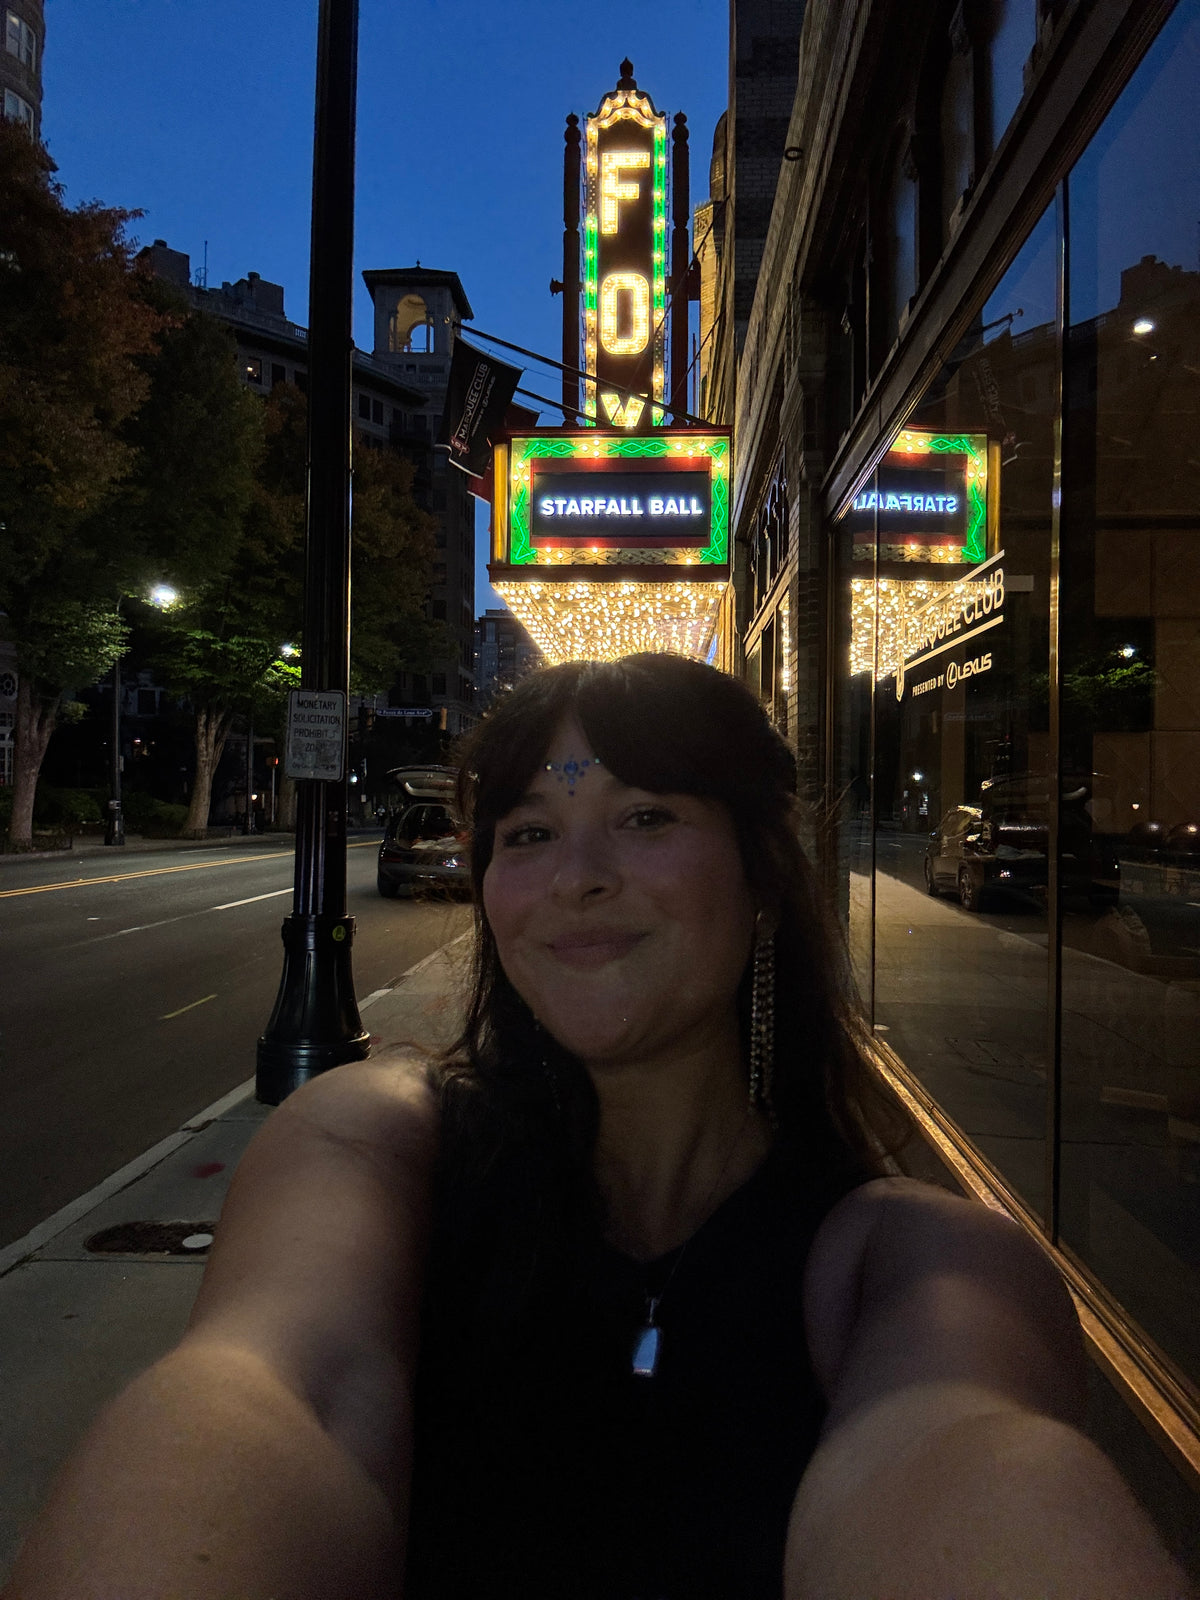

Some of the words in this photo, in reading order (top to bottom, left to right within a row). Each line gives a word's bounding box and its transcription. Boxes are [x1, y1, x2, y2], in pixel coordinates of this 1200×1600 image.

[475, 363, 488, 389] CLUB
[541, 498, 644, 516] STARFALL
[650, 498, 703, 515] BALL
[963, 568, 1004, 624] CLUB
[912, 677, 936, 697] PRESENTED
[937, 674, 945, 688] BY
[958, 652, 992, 680] LEXUS
[297, 699, 337, 710] MONETARY
[293, 713, 340, 725] SOLICITATION
